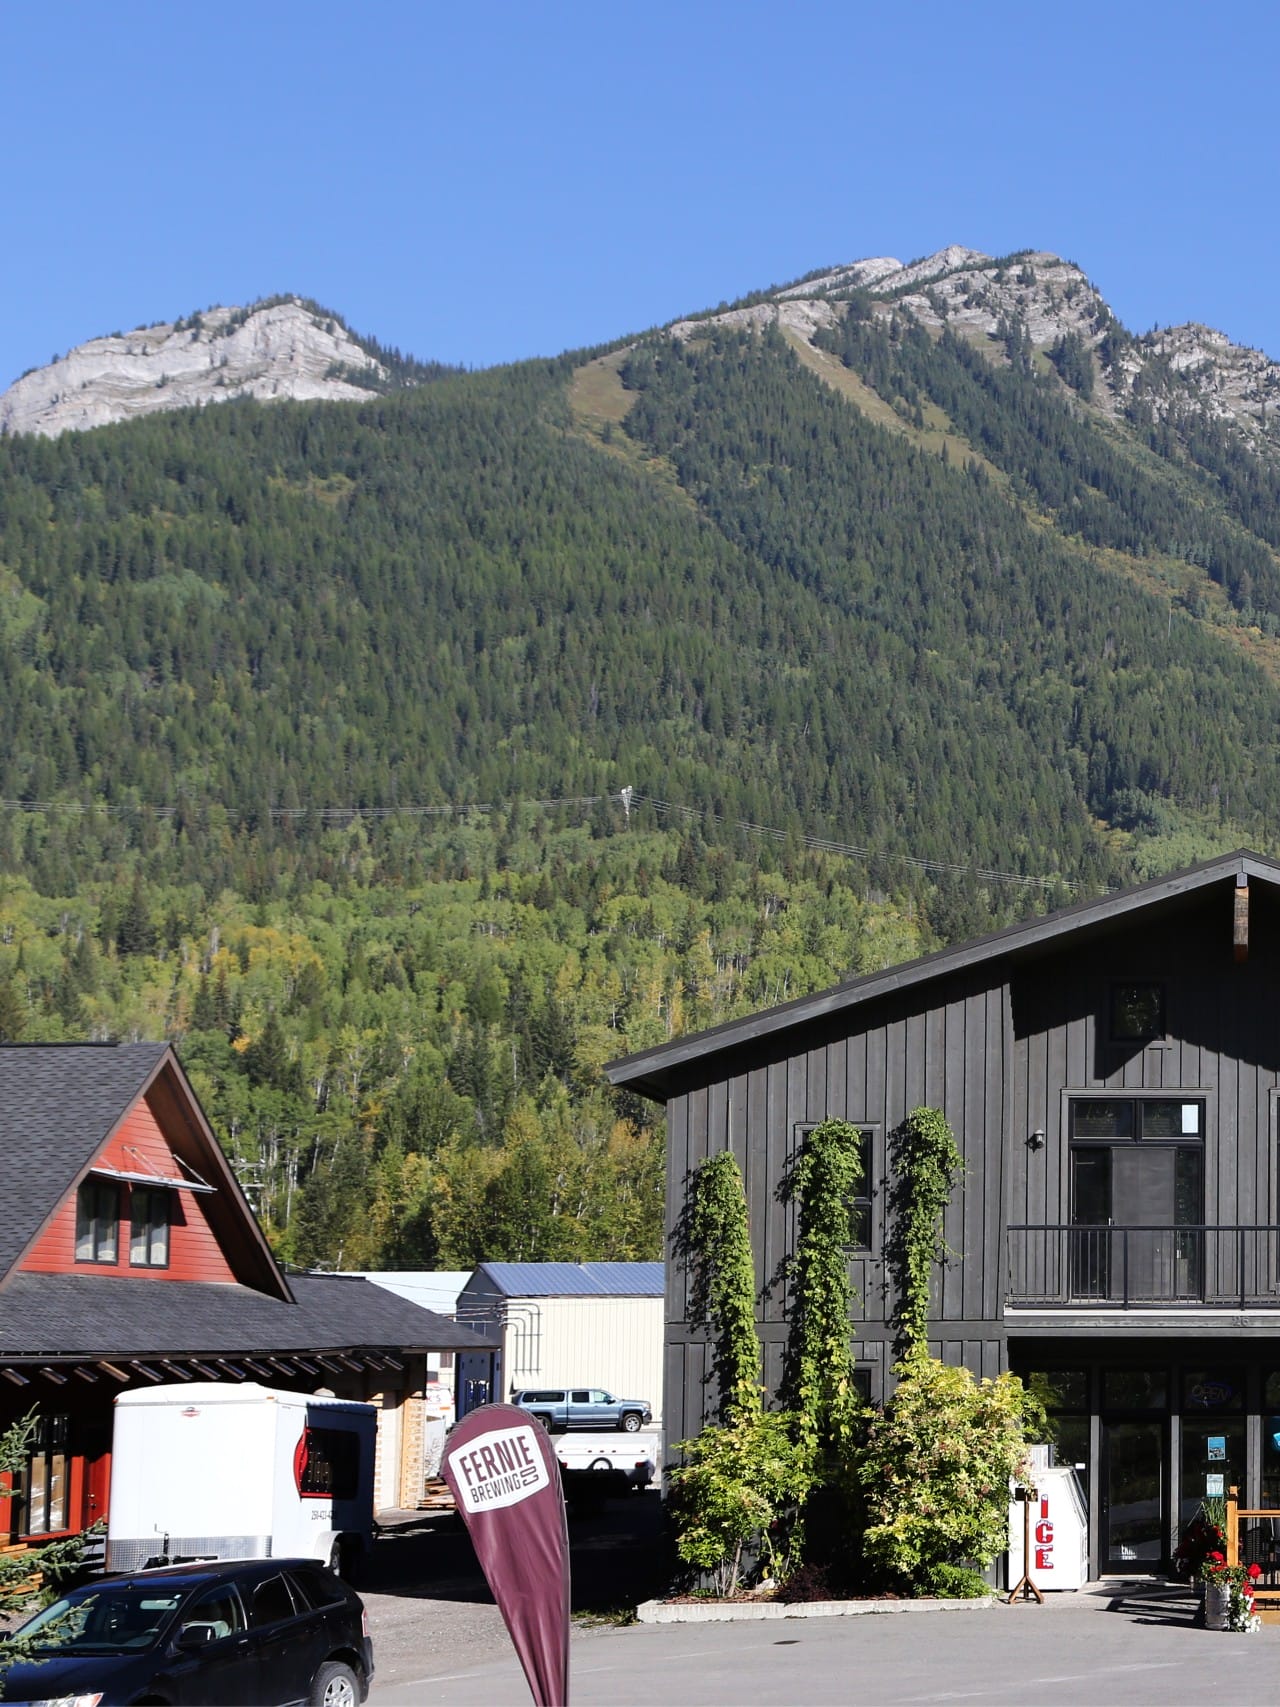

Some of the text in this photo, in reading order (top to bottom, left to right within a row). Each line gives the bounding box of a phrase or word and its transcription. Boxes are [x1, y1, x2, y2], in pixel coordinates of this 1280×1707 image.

[459, 1435, 534, 1486] FERNIE
[470, 1465, 540, 1503] BREWING CO
[1035, 1493, 1054, 1569] ICE
